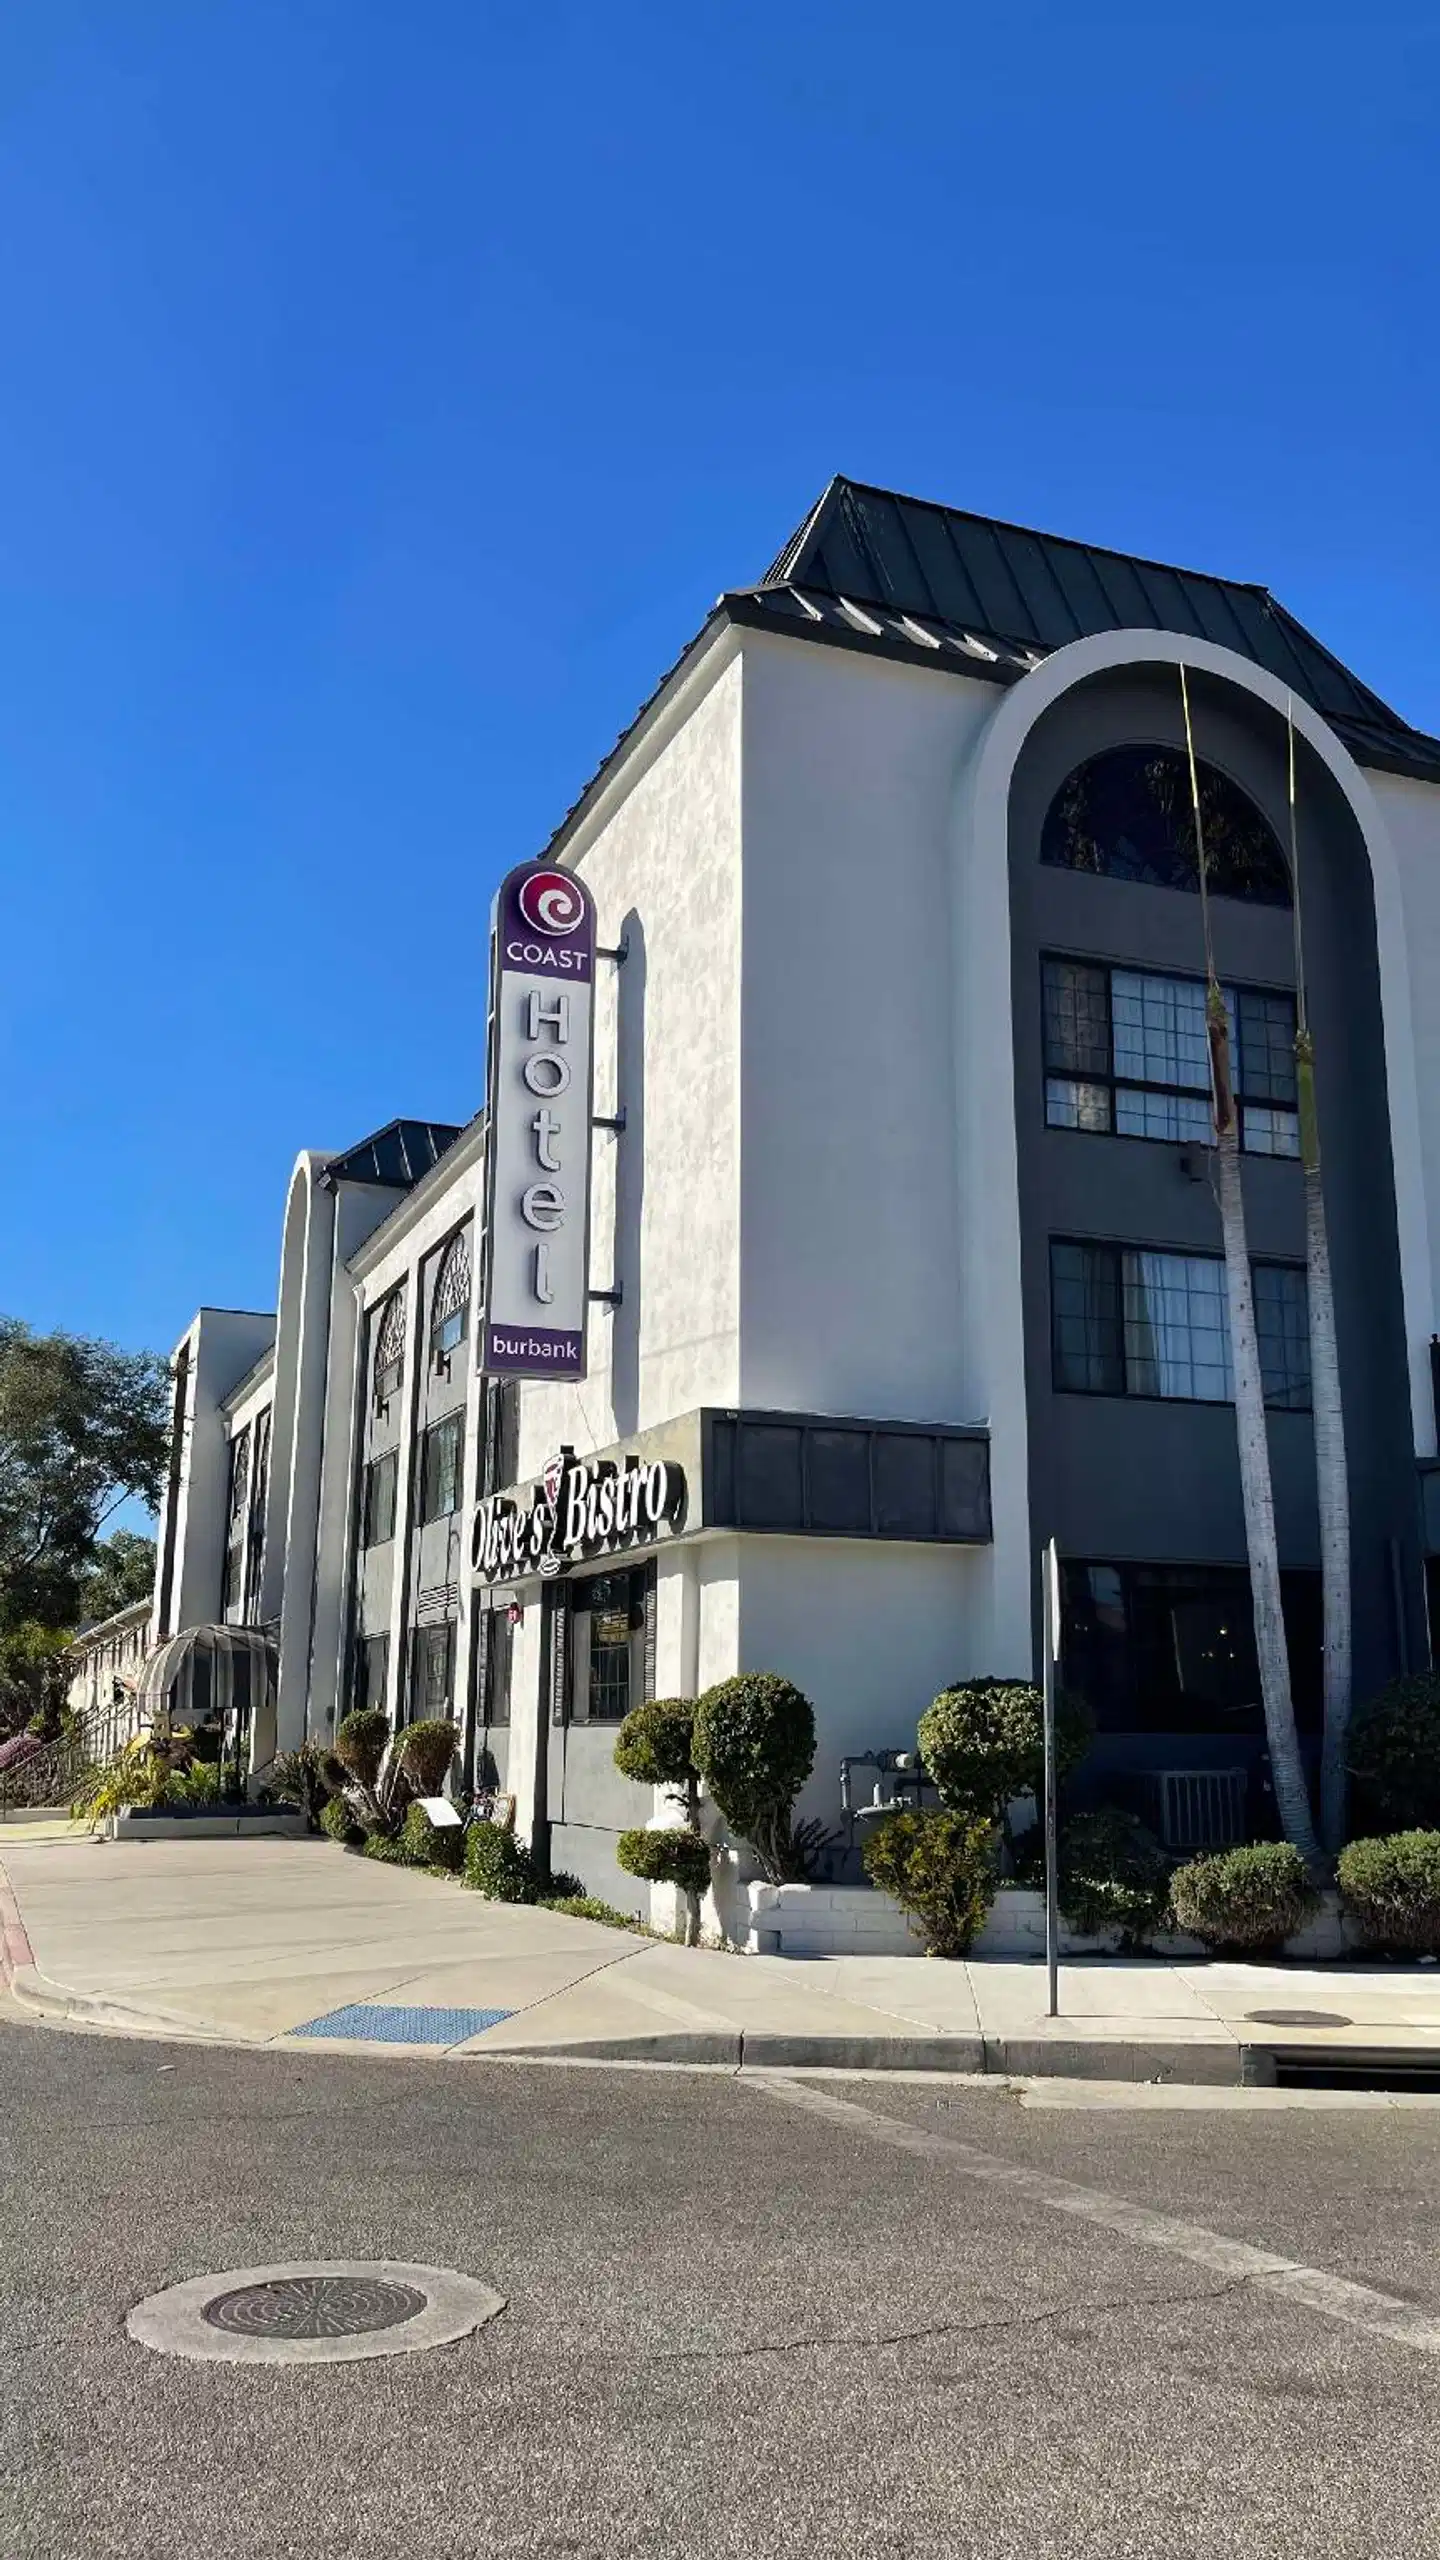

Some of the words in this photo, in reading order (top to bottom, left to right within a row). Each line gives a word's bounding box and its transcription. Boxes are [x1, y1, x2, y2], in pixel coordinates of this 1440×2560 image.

[506, 942, 588, 971] COAST
[521, 990, 571, 1304] Hotel
[493, 1335, 578, 1360] burbank
[471, 1484, 544, 1572] Olive's
[563, 1459, 668, 1548] Bistro
